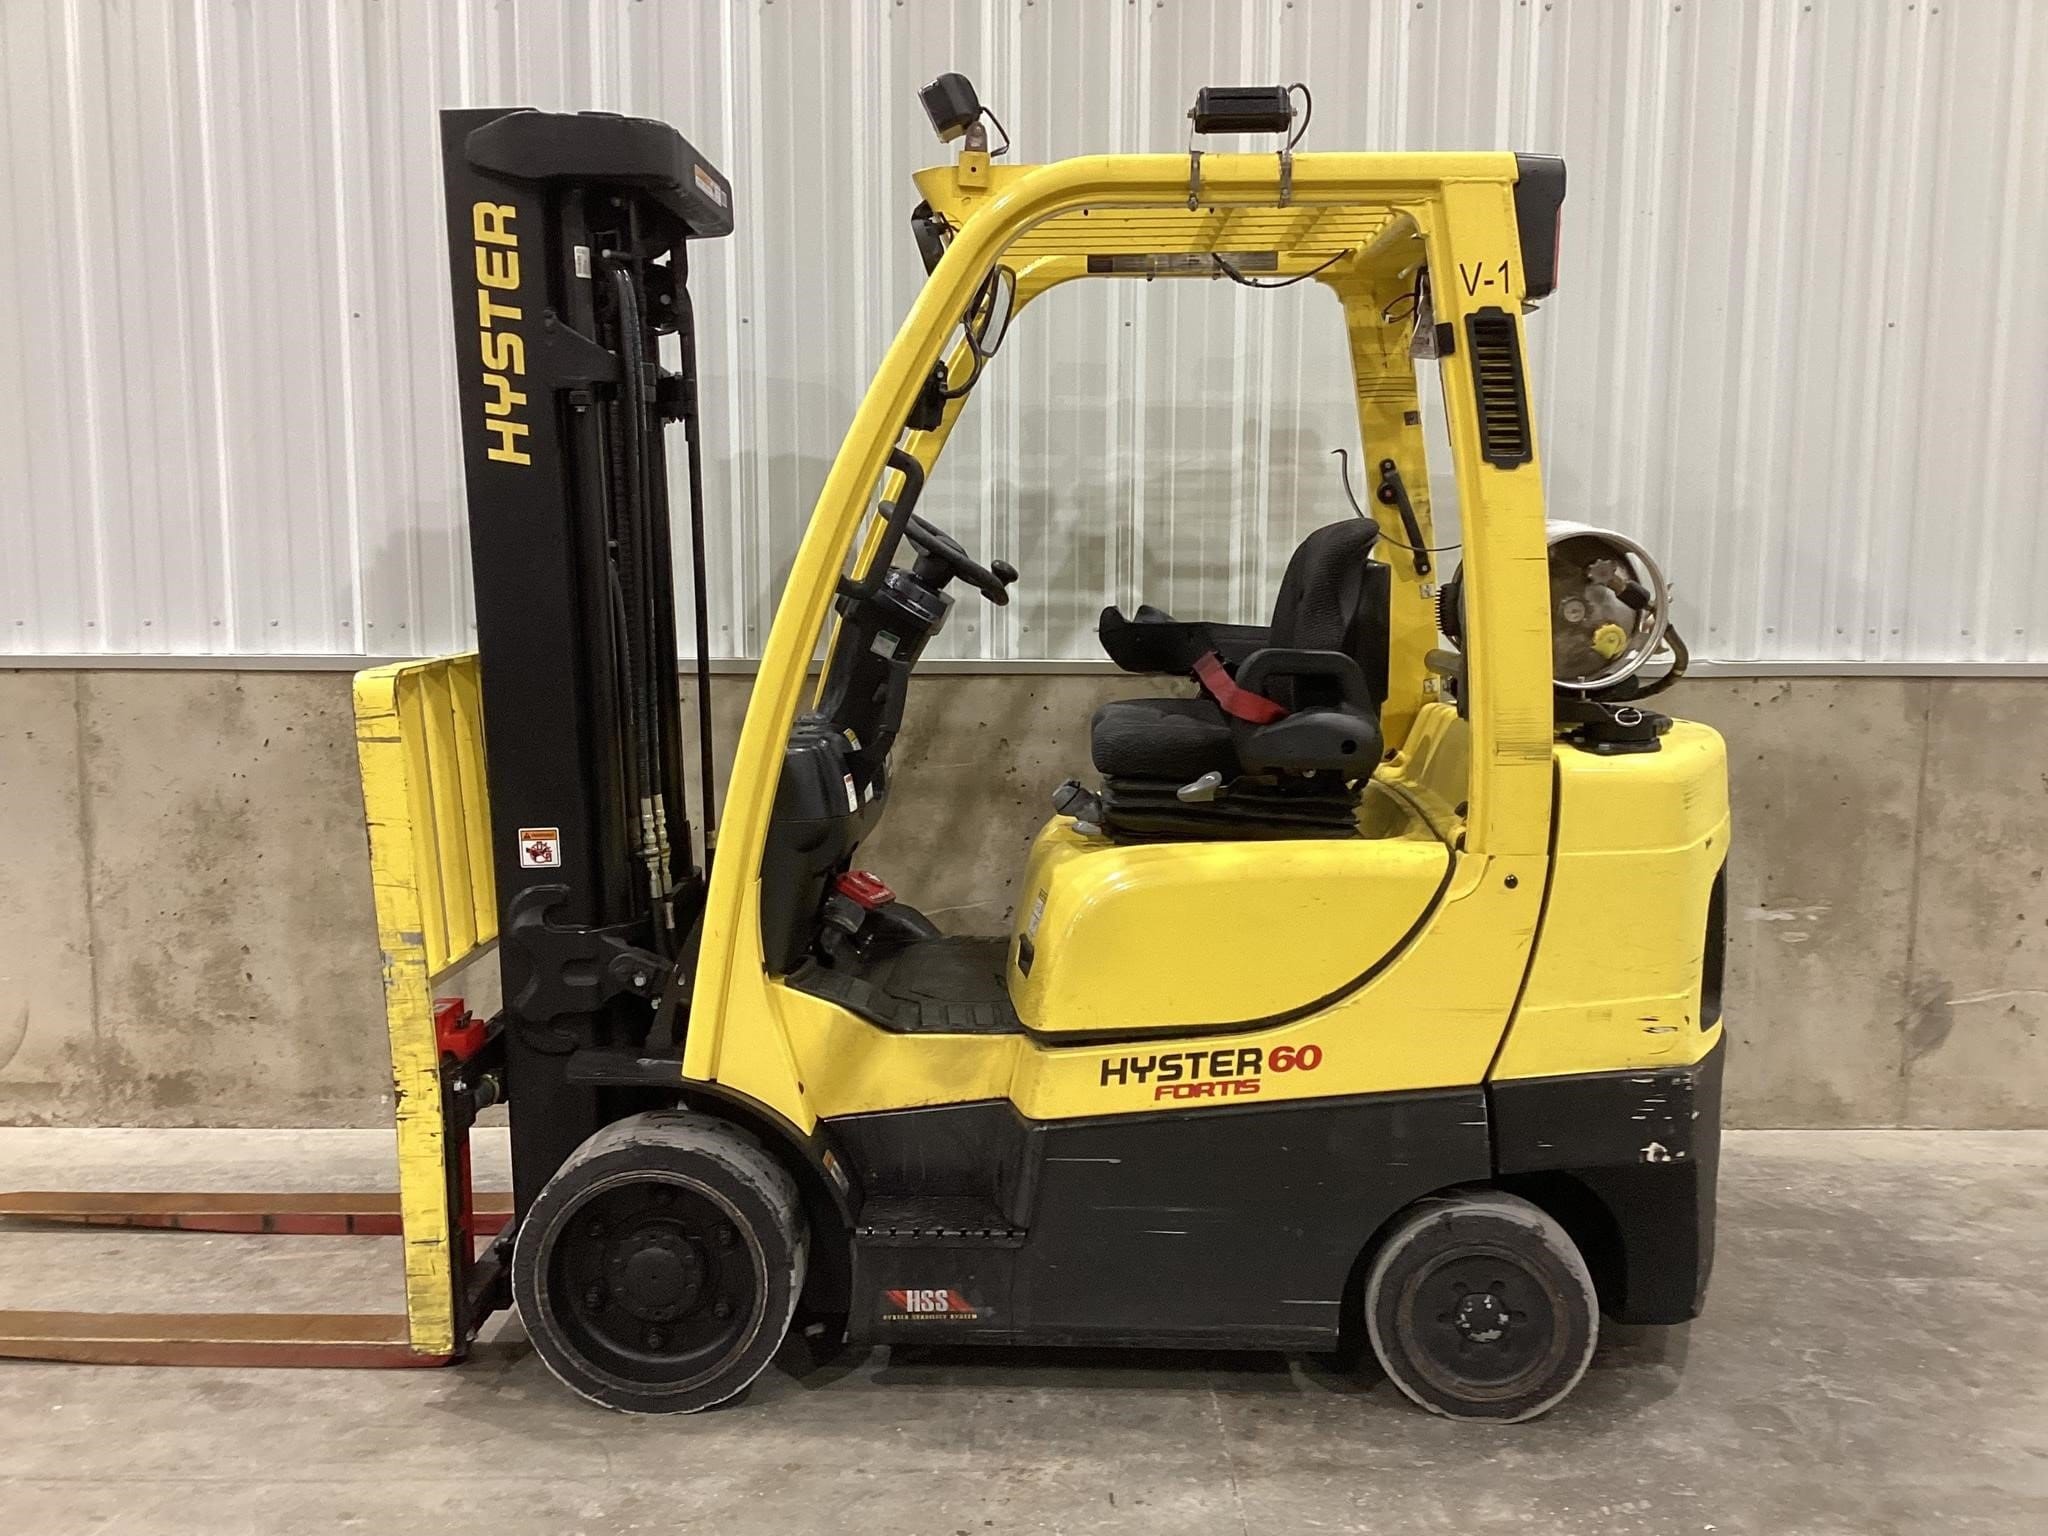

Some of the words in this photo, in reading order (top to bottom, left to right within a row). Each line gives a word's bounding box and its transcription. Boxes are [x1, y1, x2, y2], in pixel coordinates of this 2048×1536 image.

[1459, 260, 1509, 296] V-1
[472, 201, 531, 466] HYSTER
[1100, 1048, 1263, 1086] HYSTER
[1268, 1044, 1322, 1073] 60
[1154, 1079, 1261, 1101] FORTIS
[906, 1289, 949, 1312] HSS
